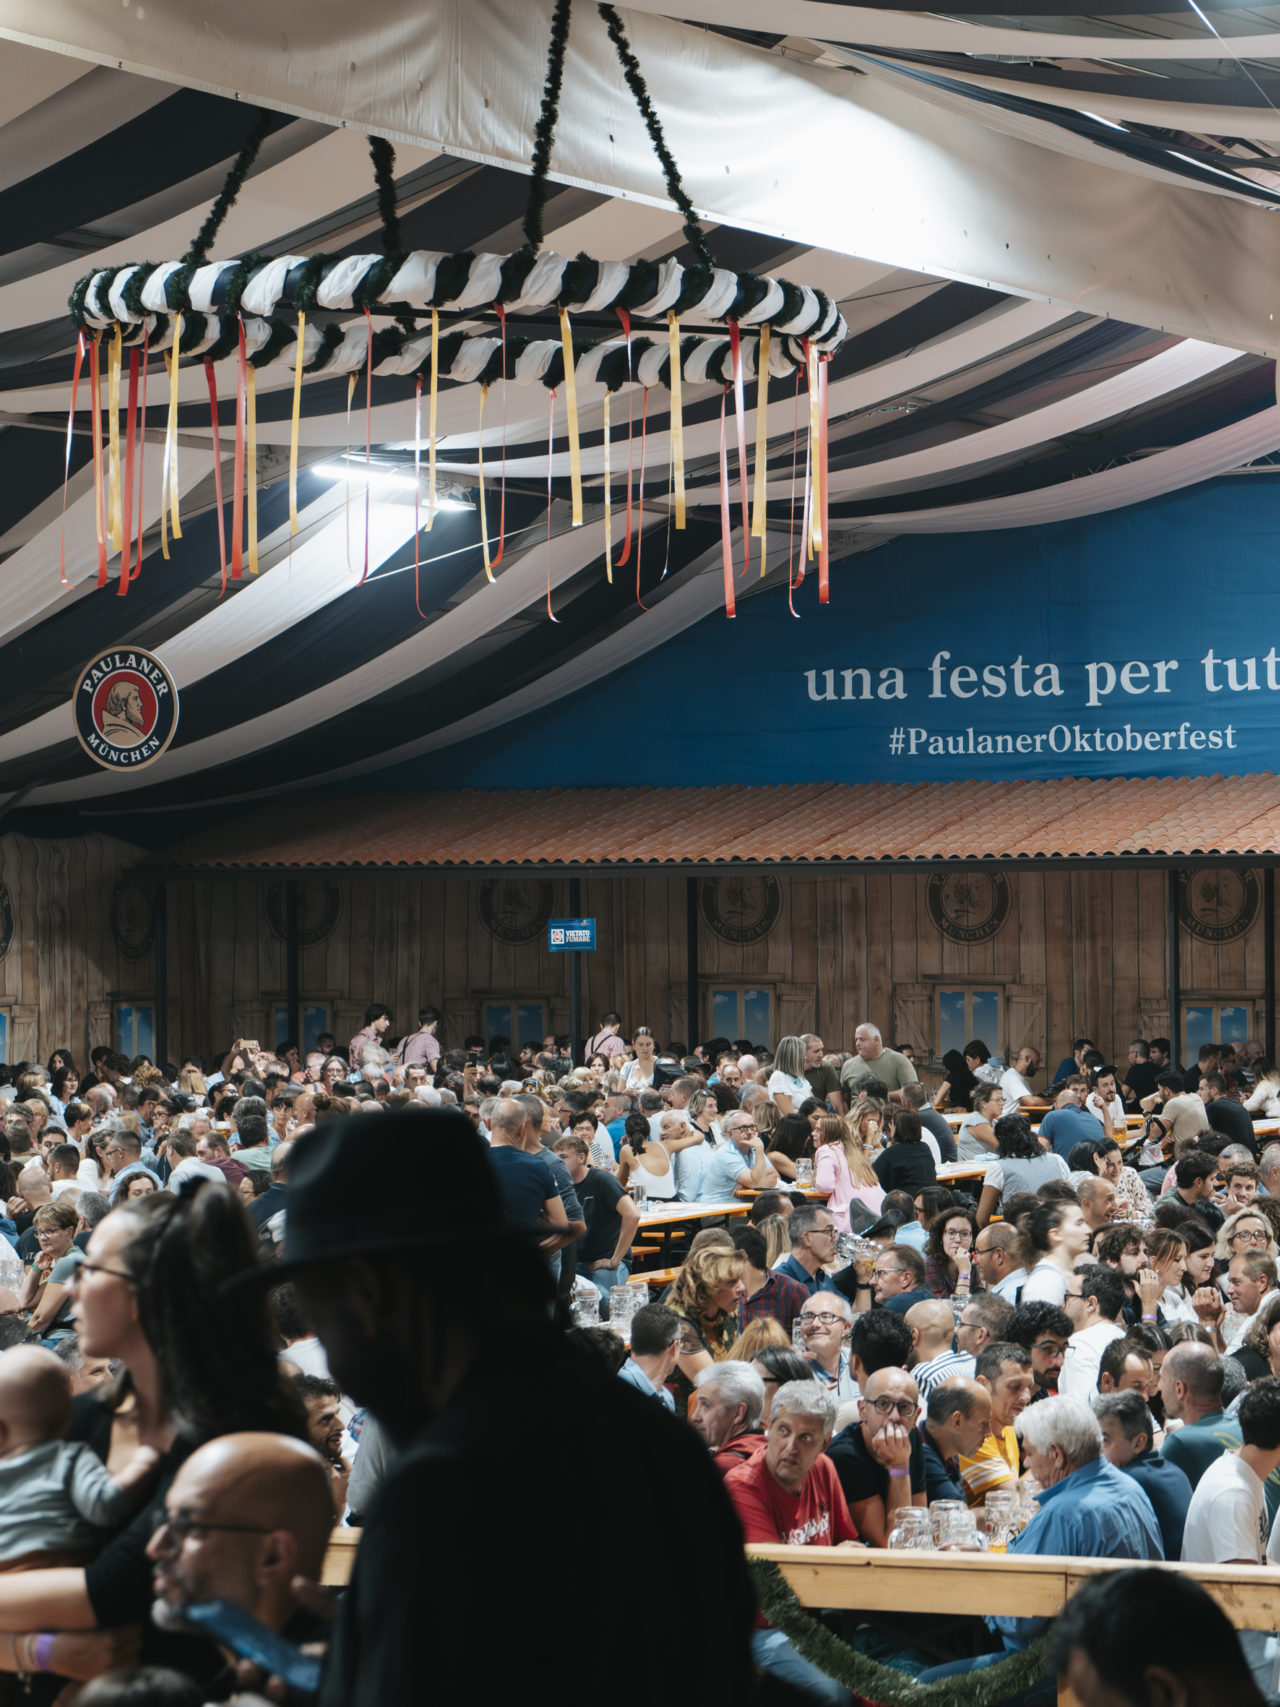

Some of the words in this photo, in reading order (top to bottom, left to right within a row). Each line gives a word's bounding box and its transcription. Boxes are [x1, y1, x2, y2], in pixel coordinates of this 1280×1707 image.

[82, 654, 169, 697] PAULANER
[803, 667, 907, 702] una
[928, 650, 1064, 698] festa
[1085, 657, 1179, 706] per
[87, 732, 160, 763] MÜNCHEN
[889, 722, 1237, 756] #PaulanerOktoberfest
[565, 929, 590, 937] VIETATO
